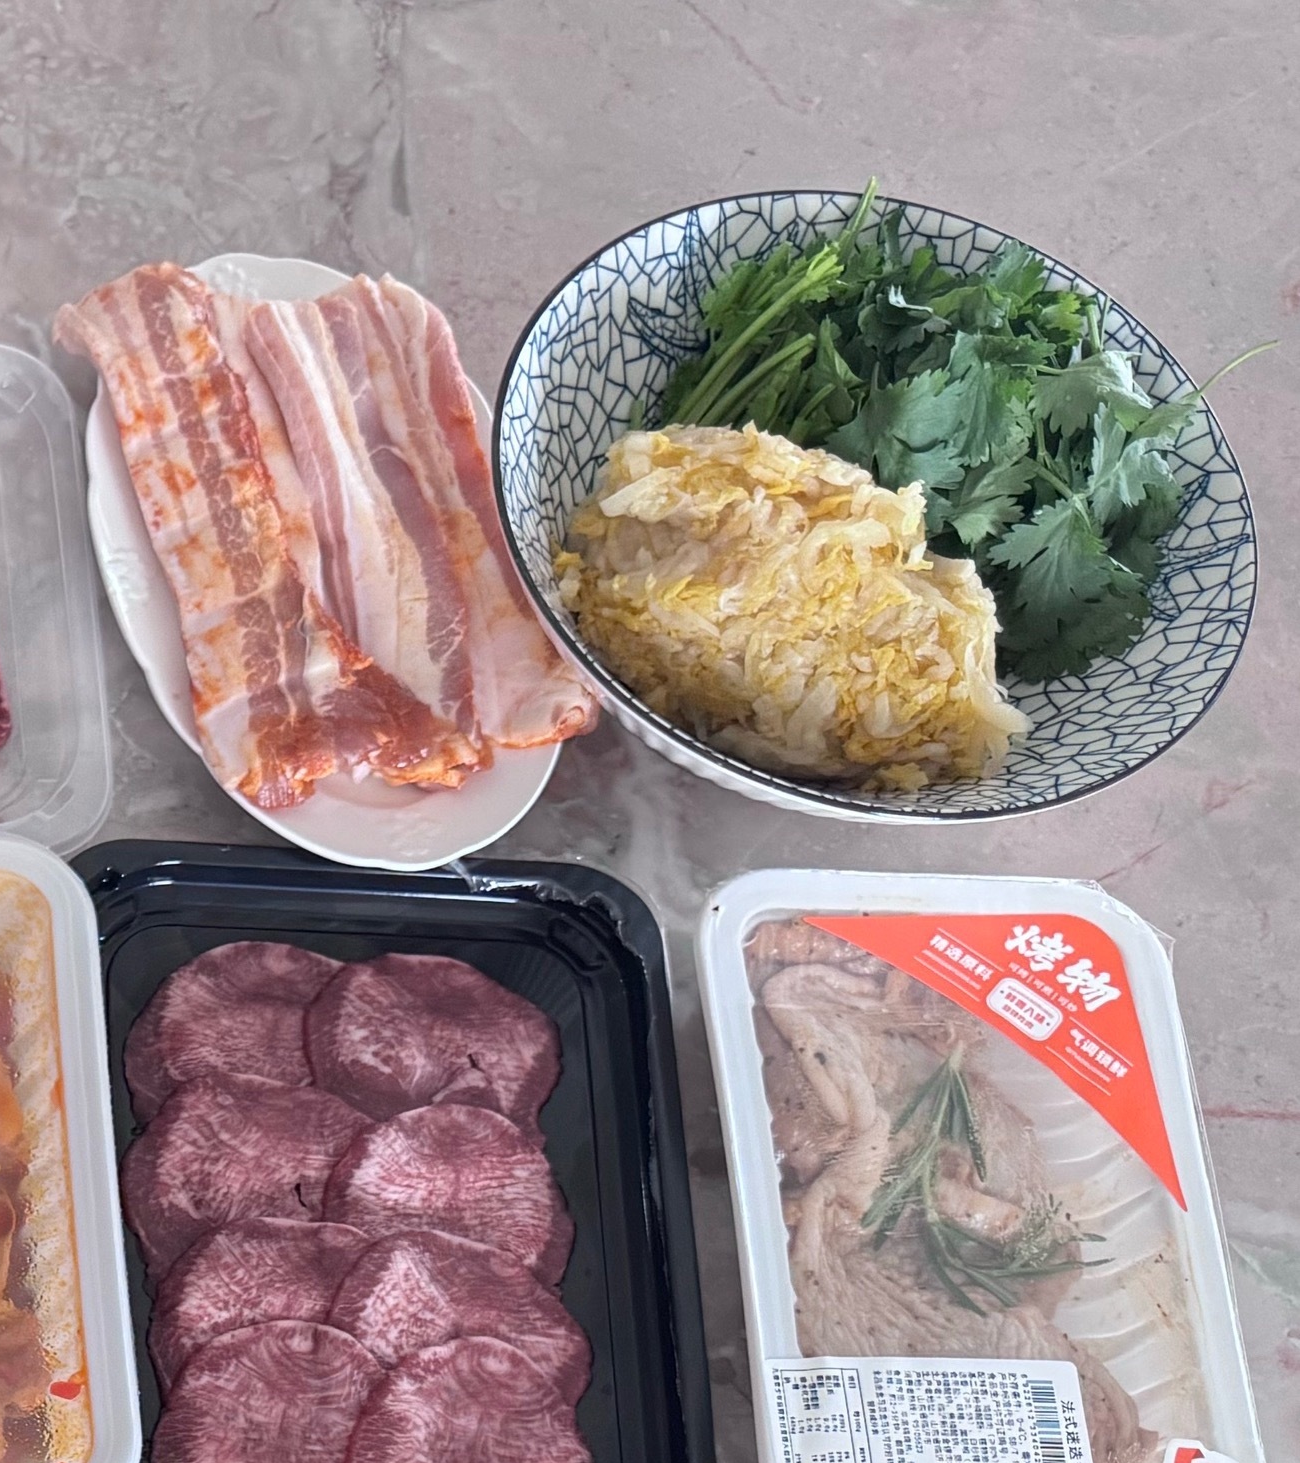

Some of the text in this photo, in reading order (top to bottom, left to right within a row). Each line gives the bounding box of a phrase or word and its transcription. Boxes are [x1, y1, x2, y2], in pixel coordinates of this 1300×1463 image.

[929, 934, 994, 982] 精选原料
[1004, 925, 1121, 1012] 烤物
